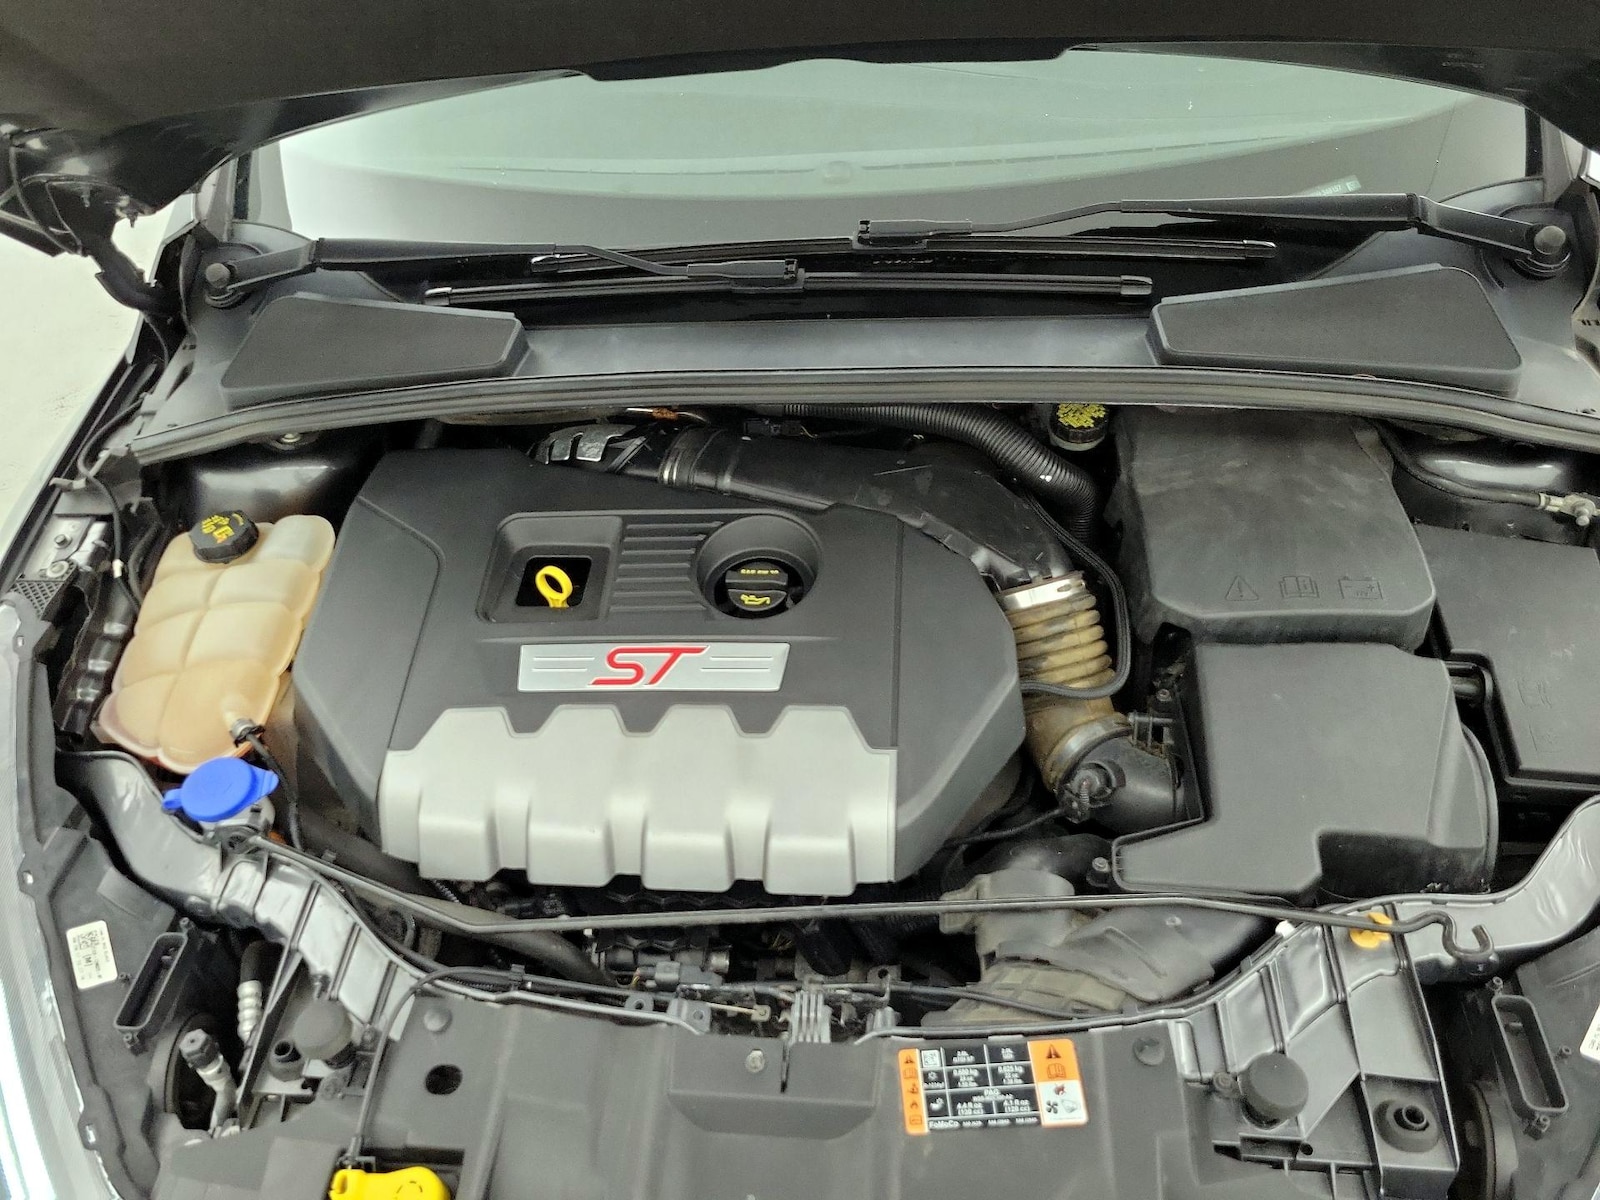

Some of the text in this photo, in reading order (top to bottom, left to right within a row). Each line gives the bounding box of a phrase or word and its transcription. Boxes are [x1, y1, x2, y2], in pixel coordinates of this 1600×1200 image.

[588, 645, 710, 687] ST
[984, 1088, 1000, 1096] PAG
[929, 1120, 959, 1129] FoMoCo
